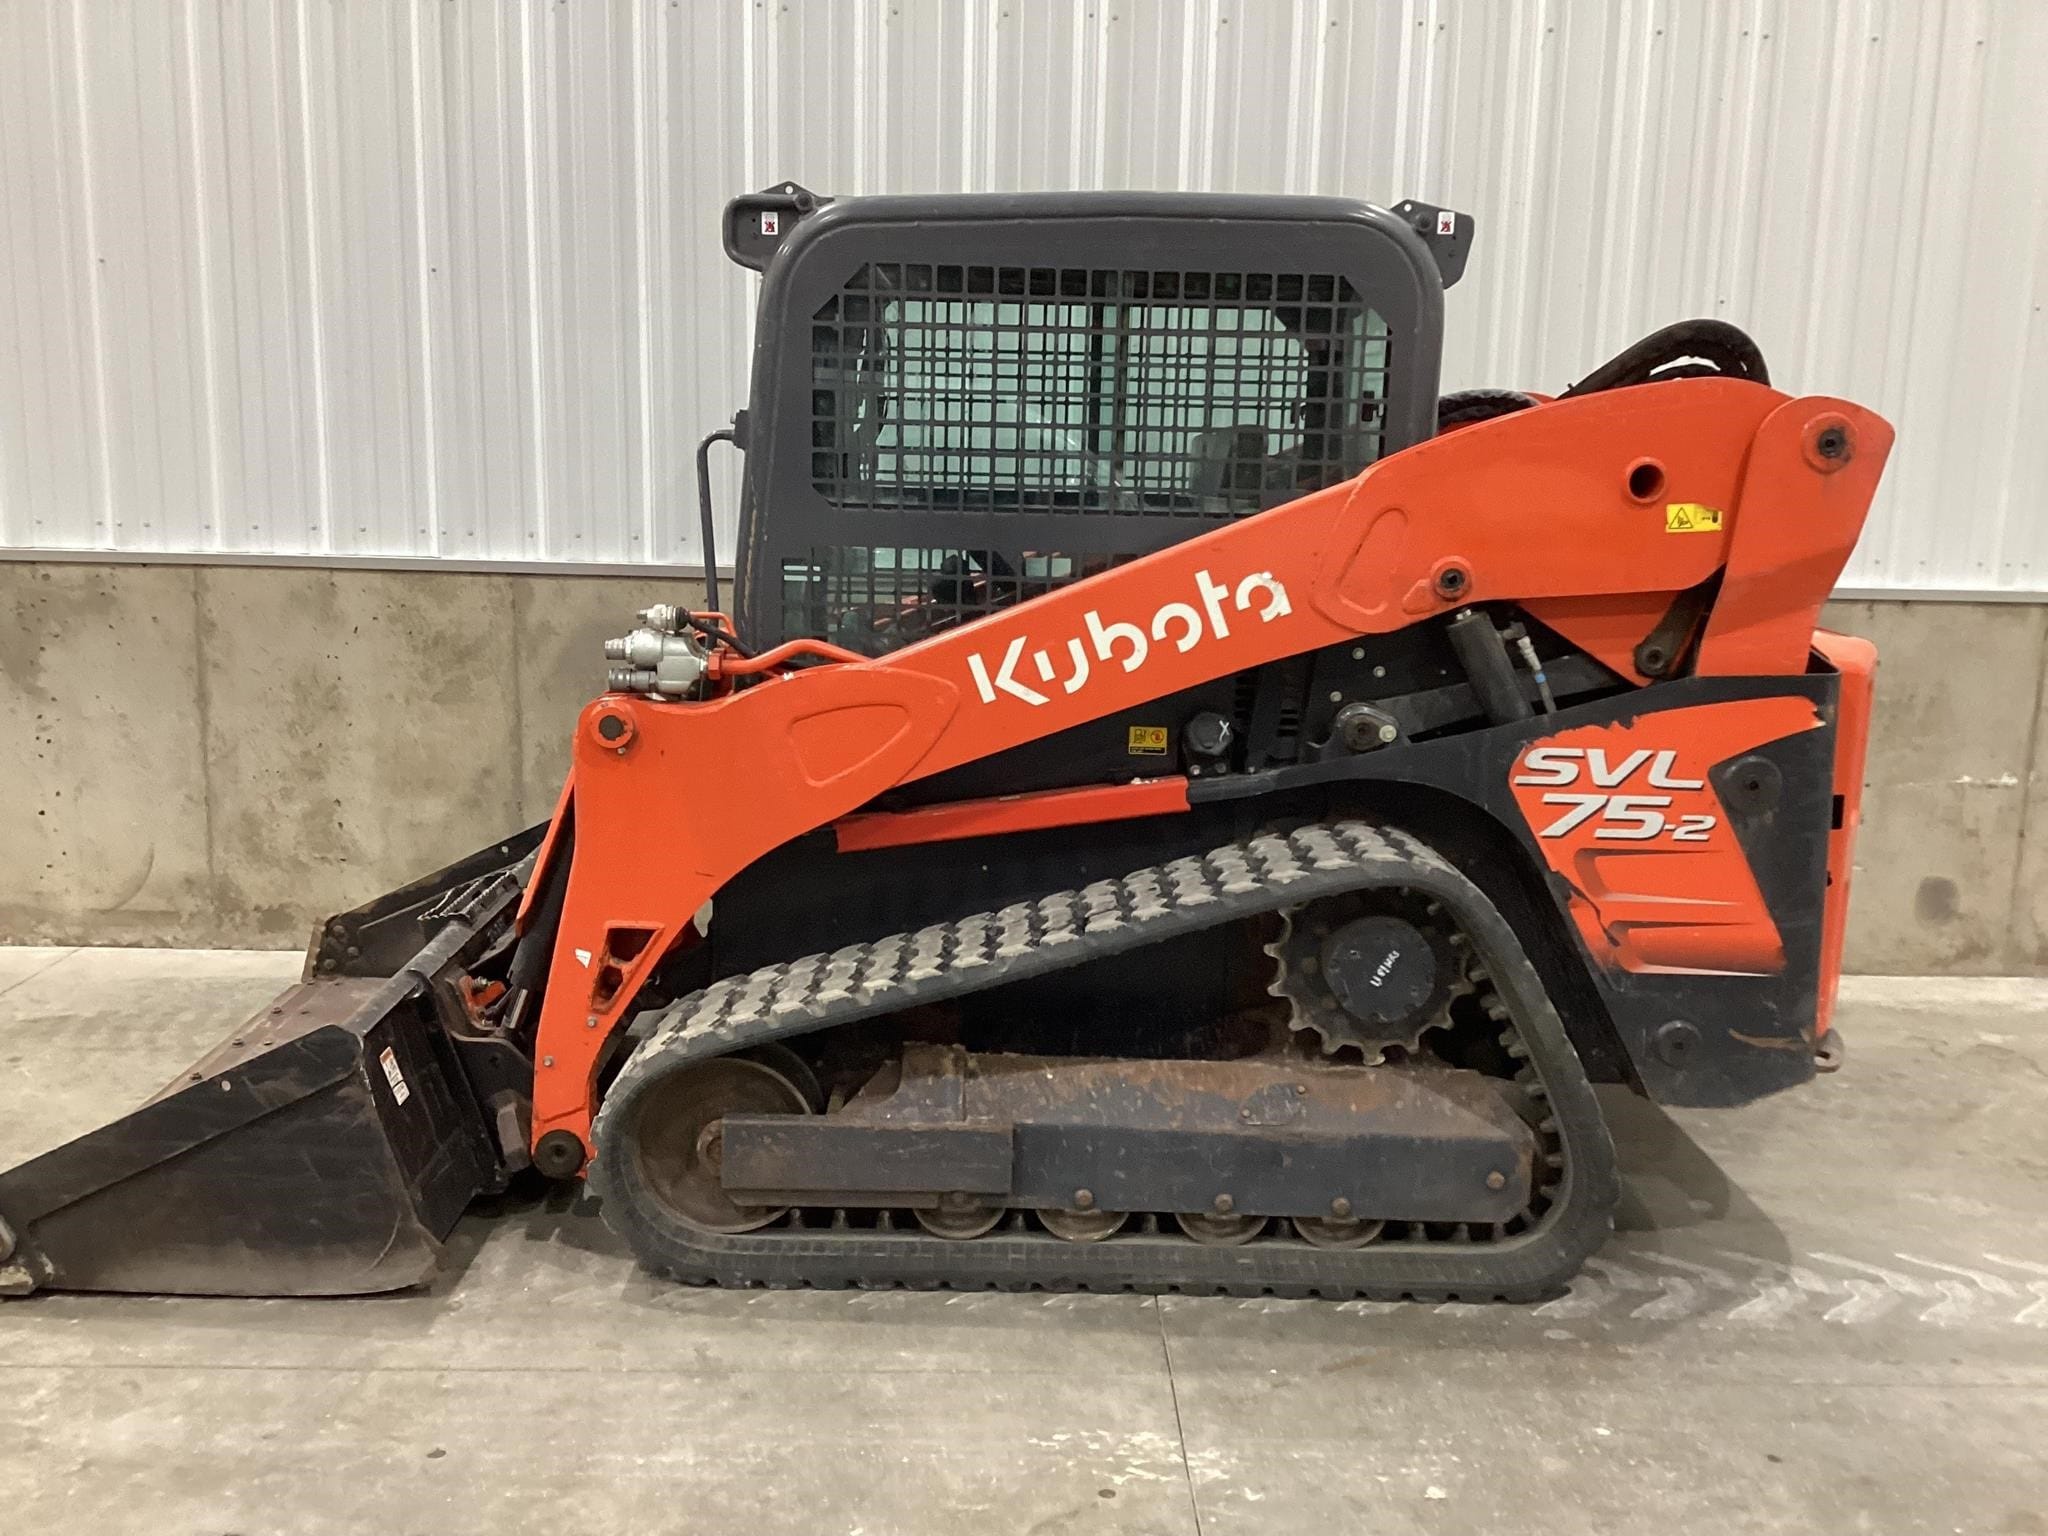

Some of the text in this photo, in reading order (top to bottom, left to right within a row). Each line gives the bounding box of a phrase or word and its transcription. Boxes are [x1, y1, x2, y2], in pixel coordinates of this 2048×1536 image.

[966, 569, 1293, 706] Kubota
[1513, 747, 1705, 789] SVL
[1537, 792, 1717, 841] 75-2
